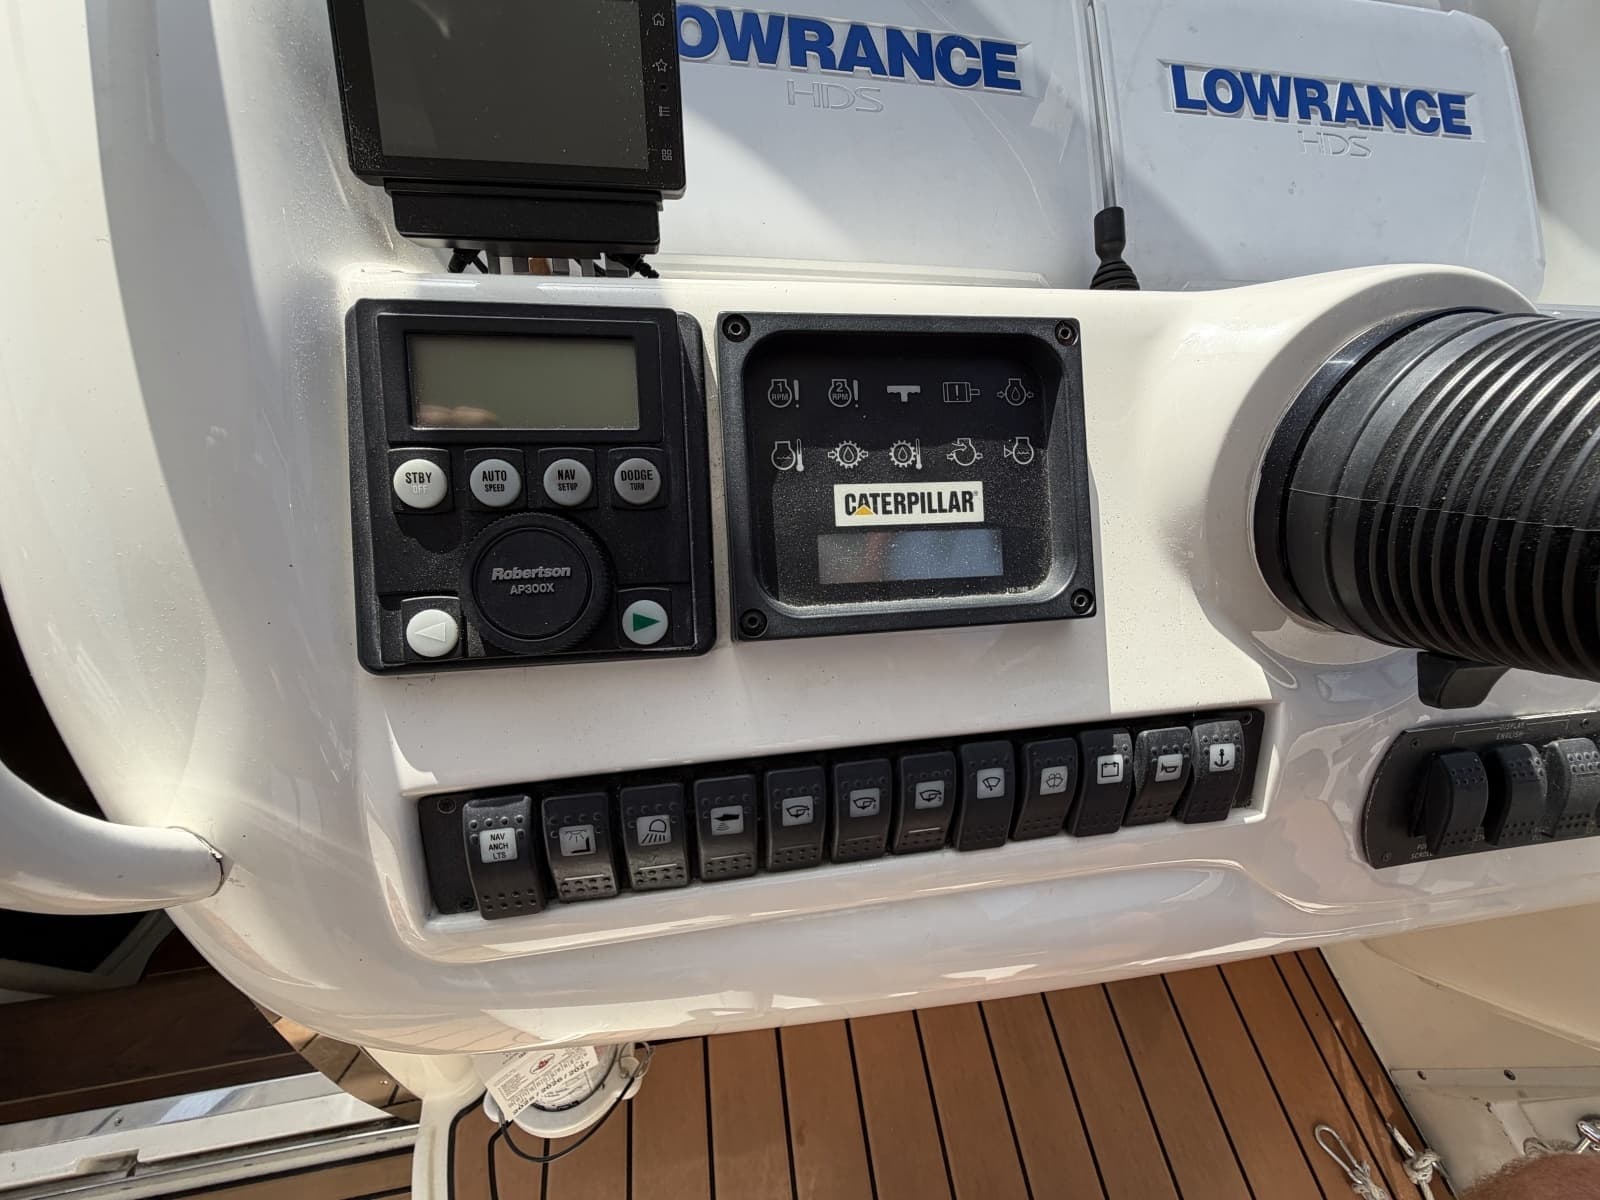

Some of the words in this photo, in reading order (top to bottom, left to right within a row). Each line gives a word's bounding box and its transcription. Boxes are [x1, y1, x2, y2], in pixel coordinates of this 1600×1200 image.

[677, 4, 1022, 91] OWRANCE
[786, 79, 883, 113] HDS
[1171, 64, 1472, 135] LOWRANCE
[1298, 129, 1373, 158] HDS
[771, 393, 789, 401] RPM
[831, 393, 849, 401] RPM
[405, 472, 432, 484] STBY
[482, 470, 507, 482] AUTO
[557, 469, 576, 481] NAV
[620, 470, 654, 481] DODGE
[412, 485, 428, 494] OFF
[484, 484, 505, 493] SPEED
[558, 482, 578, 491] SETUP
[630, 482, 645, 491] TURN
[844, 490, 975, 516] CATERPILLAR
[491, 566, 572, 581] Robertson
[510, 583, 555, 595] AP300X
[490, 832, 505, 841] NAV
[488, 843, 509, 851] ANCH
[492, 851, 507, 860] LTS
